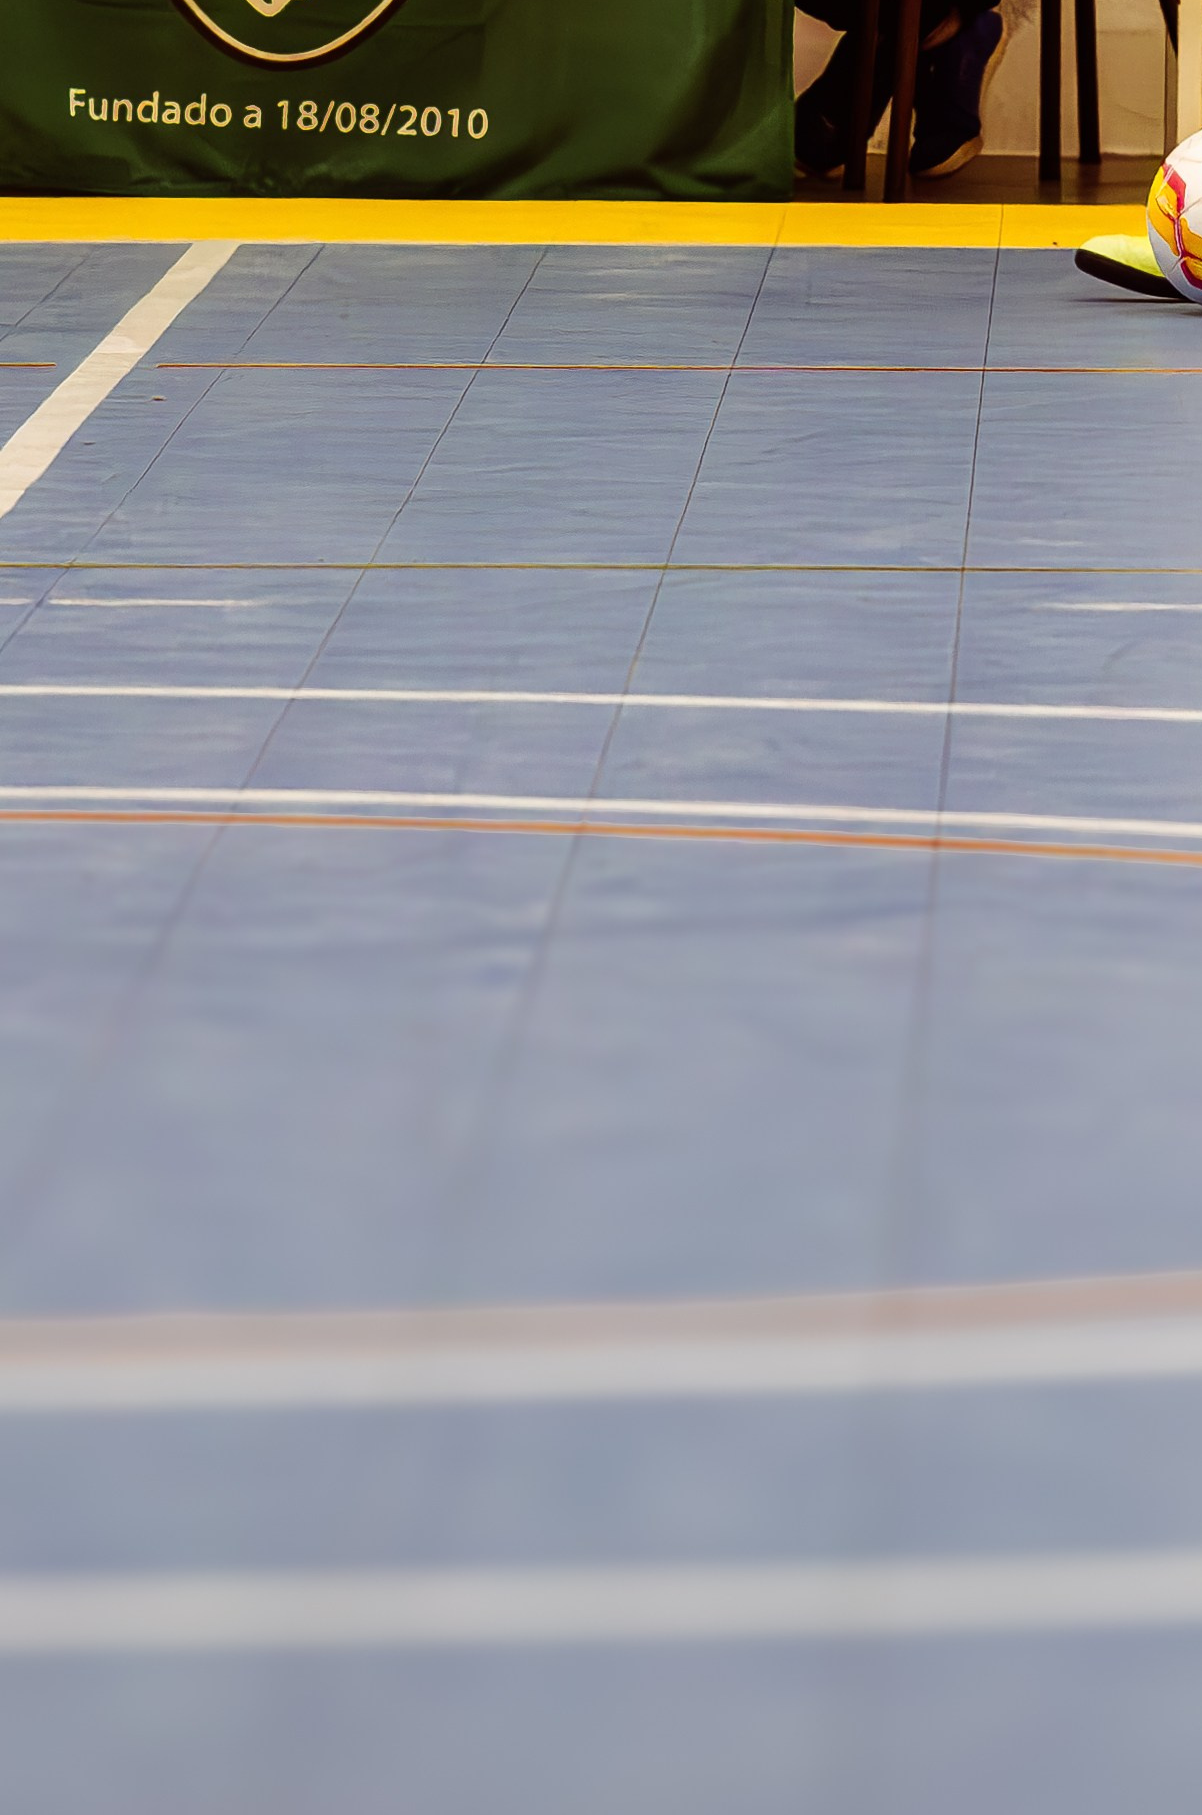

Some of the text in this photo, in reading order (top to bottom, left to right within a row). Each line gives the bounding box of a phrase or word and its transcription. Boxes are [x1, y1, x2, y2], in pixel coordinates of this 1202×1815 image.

[69, 88, 489, 140] Fundado a 18/08/2010
